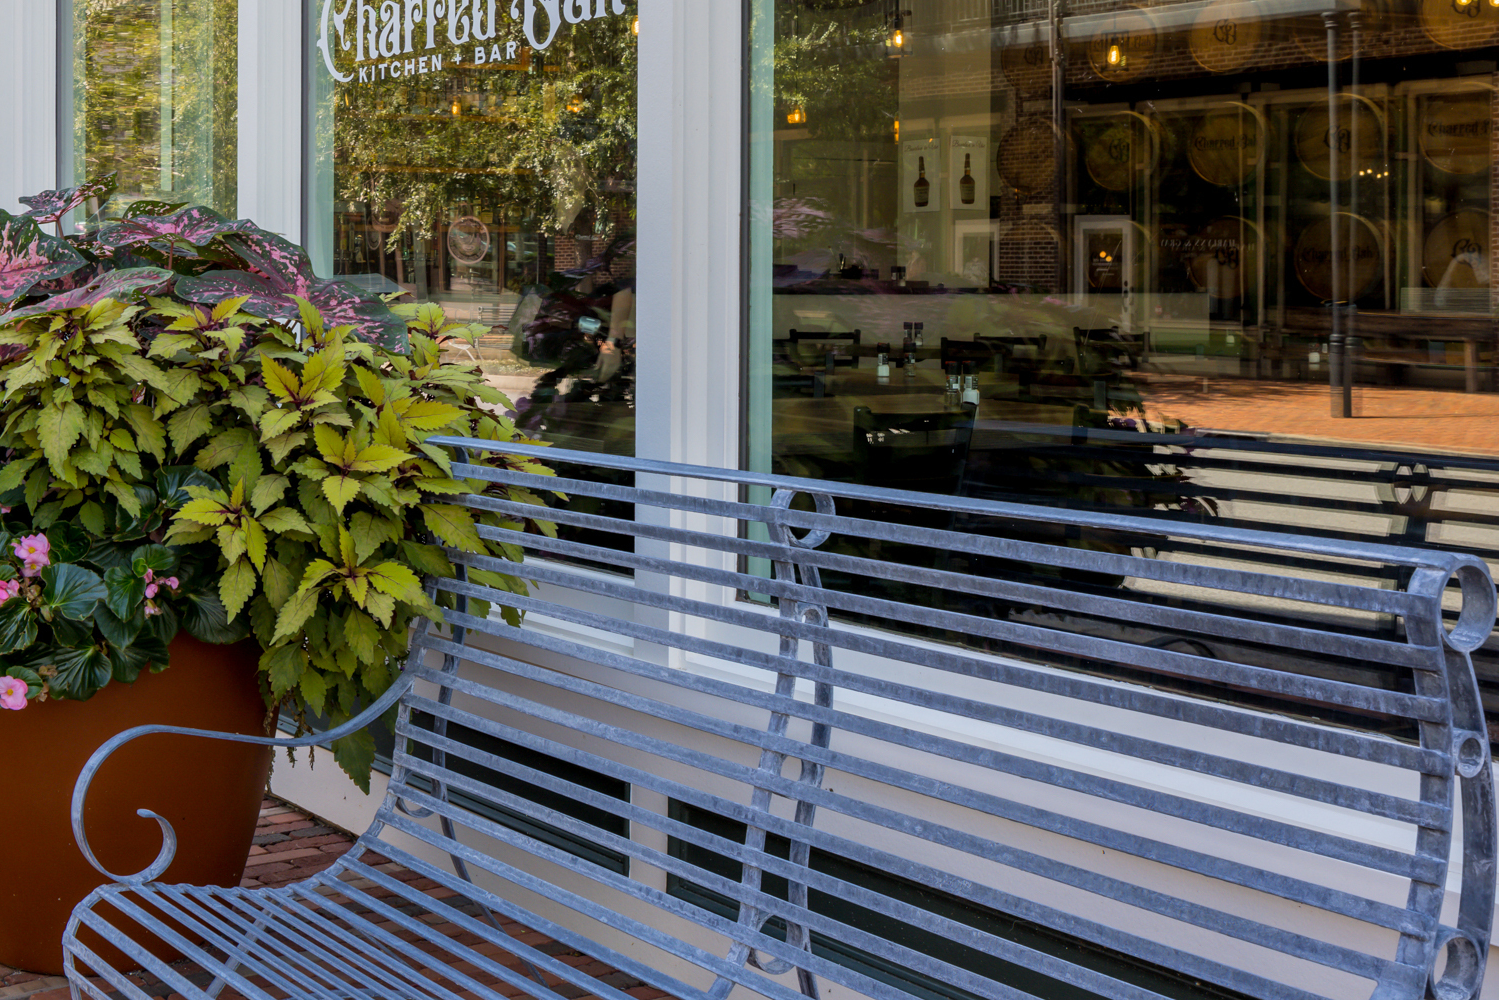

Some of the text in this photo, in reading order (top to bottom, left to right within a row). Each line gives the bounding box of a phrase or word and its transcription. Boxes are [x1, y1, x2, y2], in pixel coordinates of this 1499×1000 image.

[358, 41, 517, 83] KITCHEN + BAR
